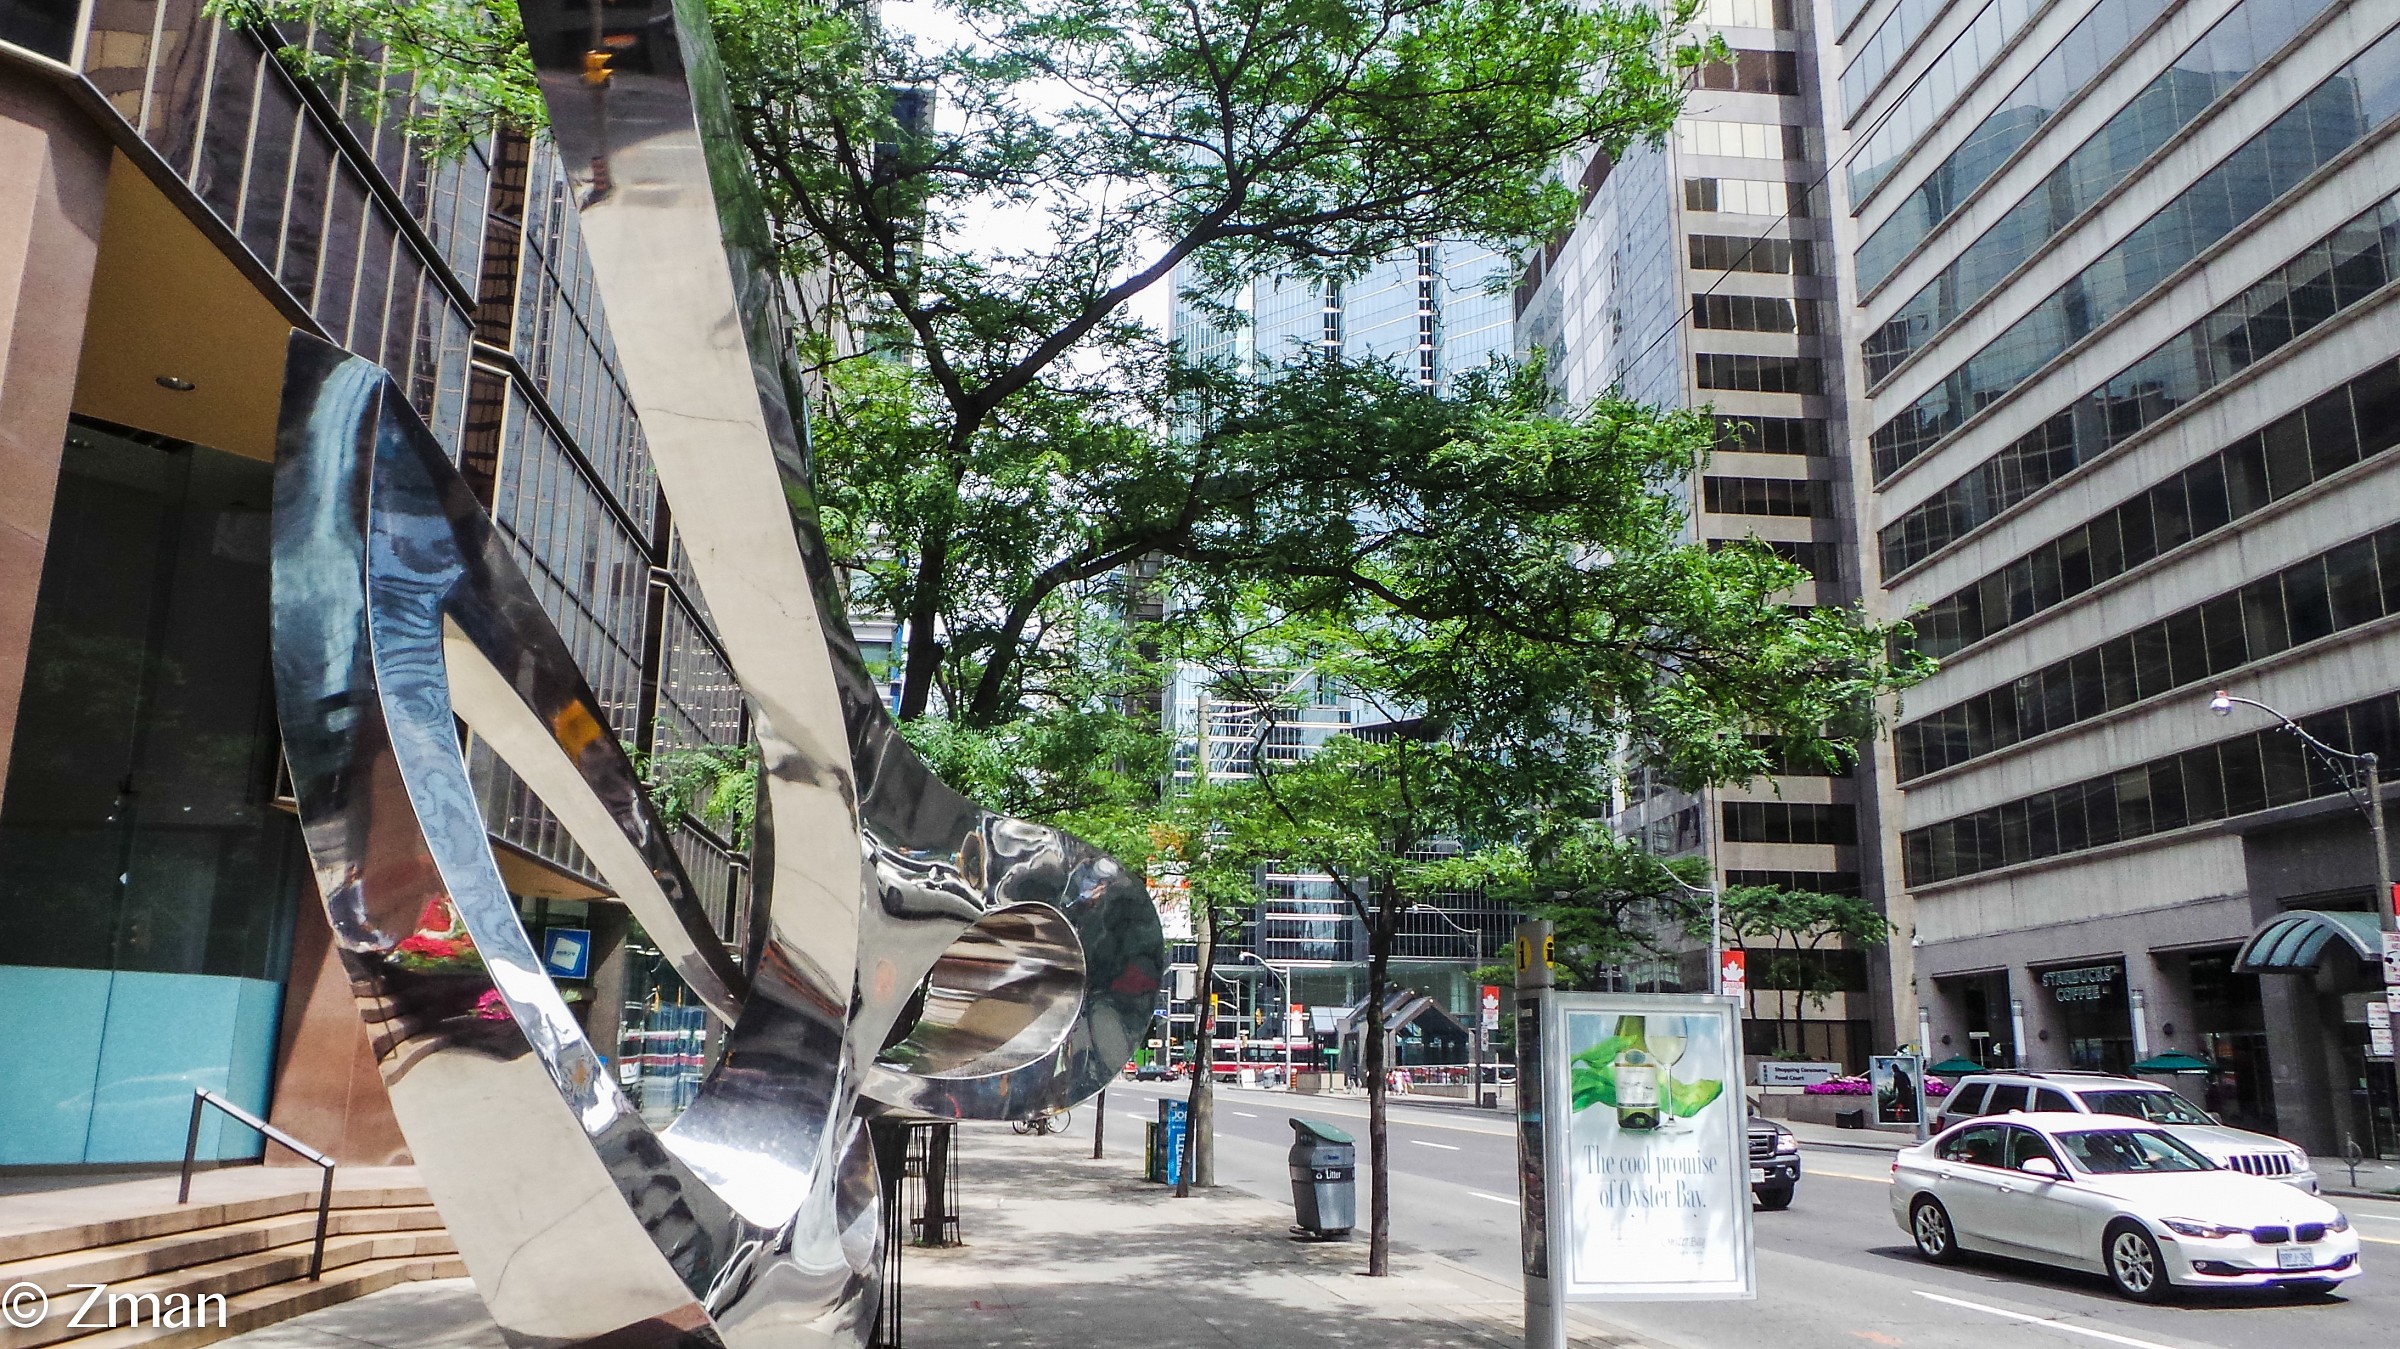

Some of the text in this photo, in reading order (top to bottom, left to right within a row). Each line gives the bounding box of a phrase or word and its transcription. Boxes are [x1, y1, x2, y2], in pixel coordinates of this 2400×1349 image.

[2043, 965, 2112, 987] STARBUCKS
[2056, 985, 2100, 1001] COFFEE
[1325, 1168, 1341, 1179] Litter
[1584, 1145, 1717, 1184] The cool promise
[1600, 1180, 1706, 1217] of Oyster Bay.
